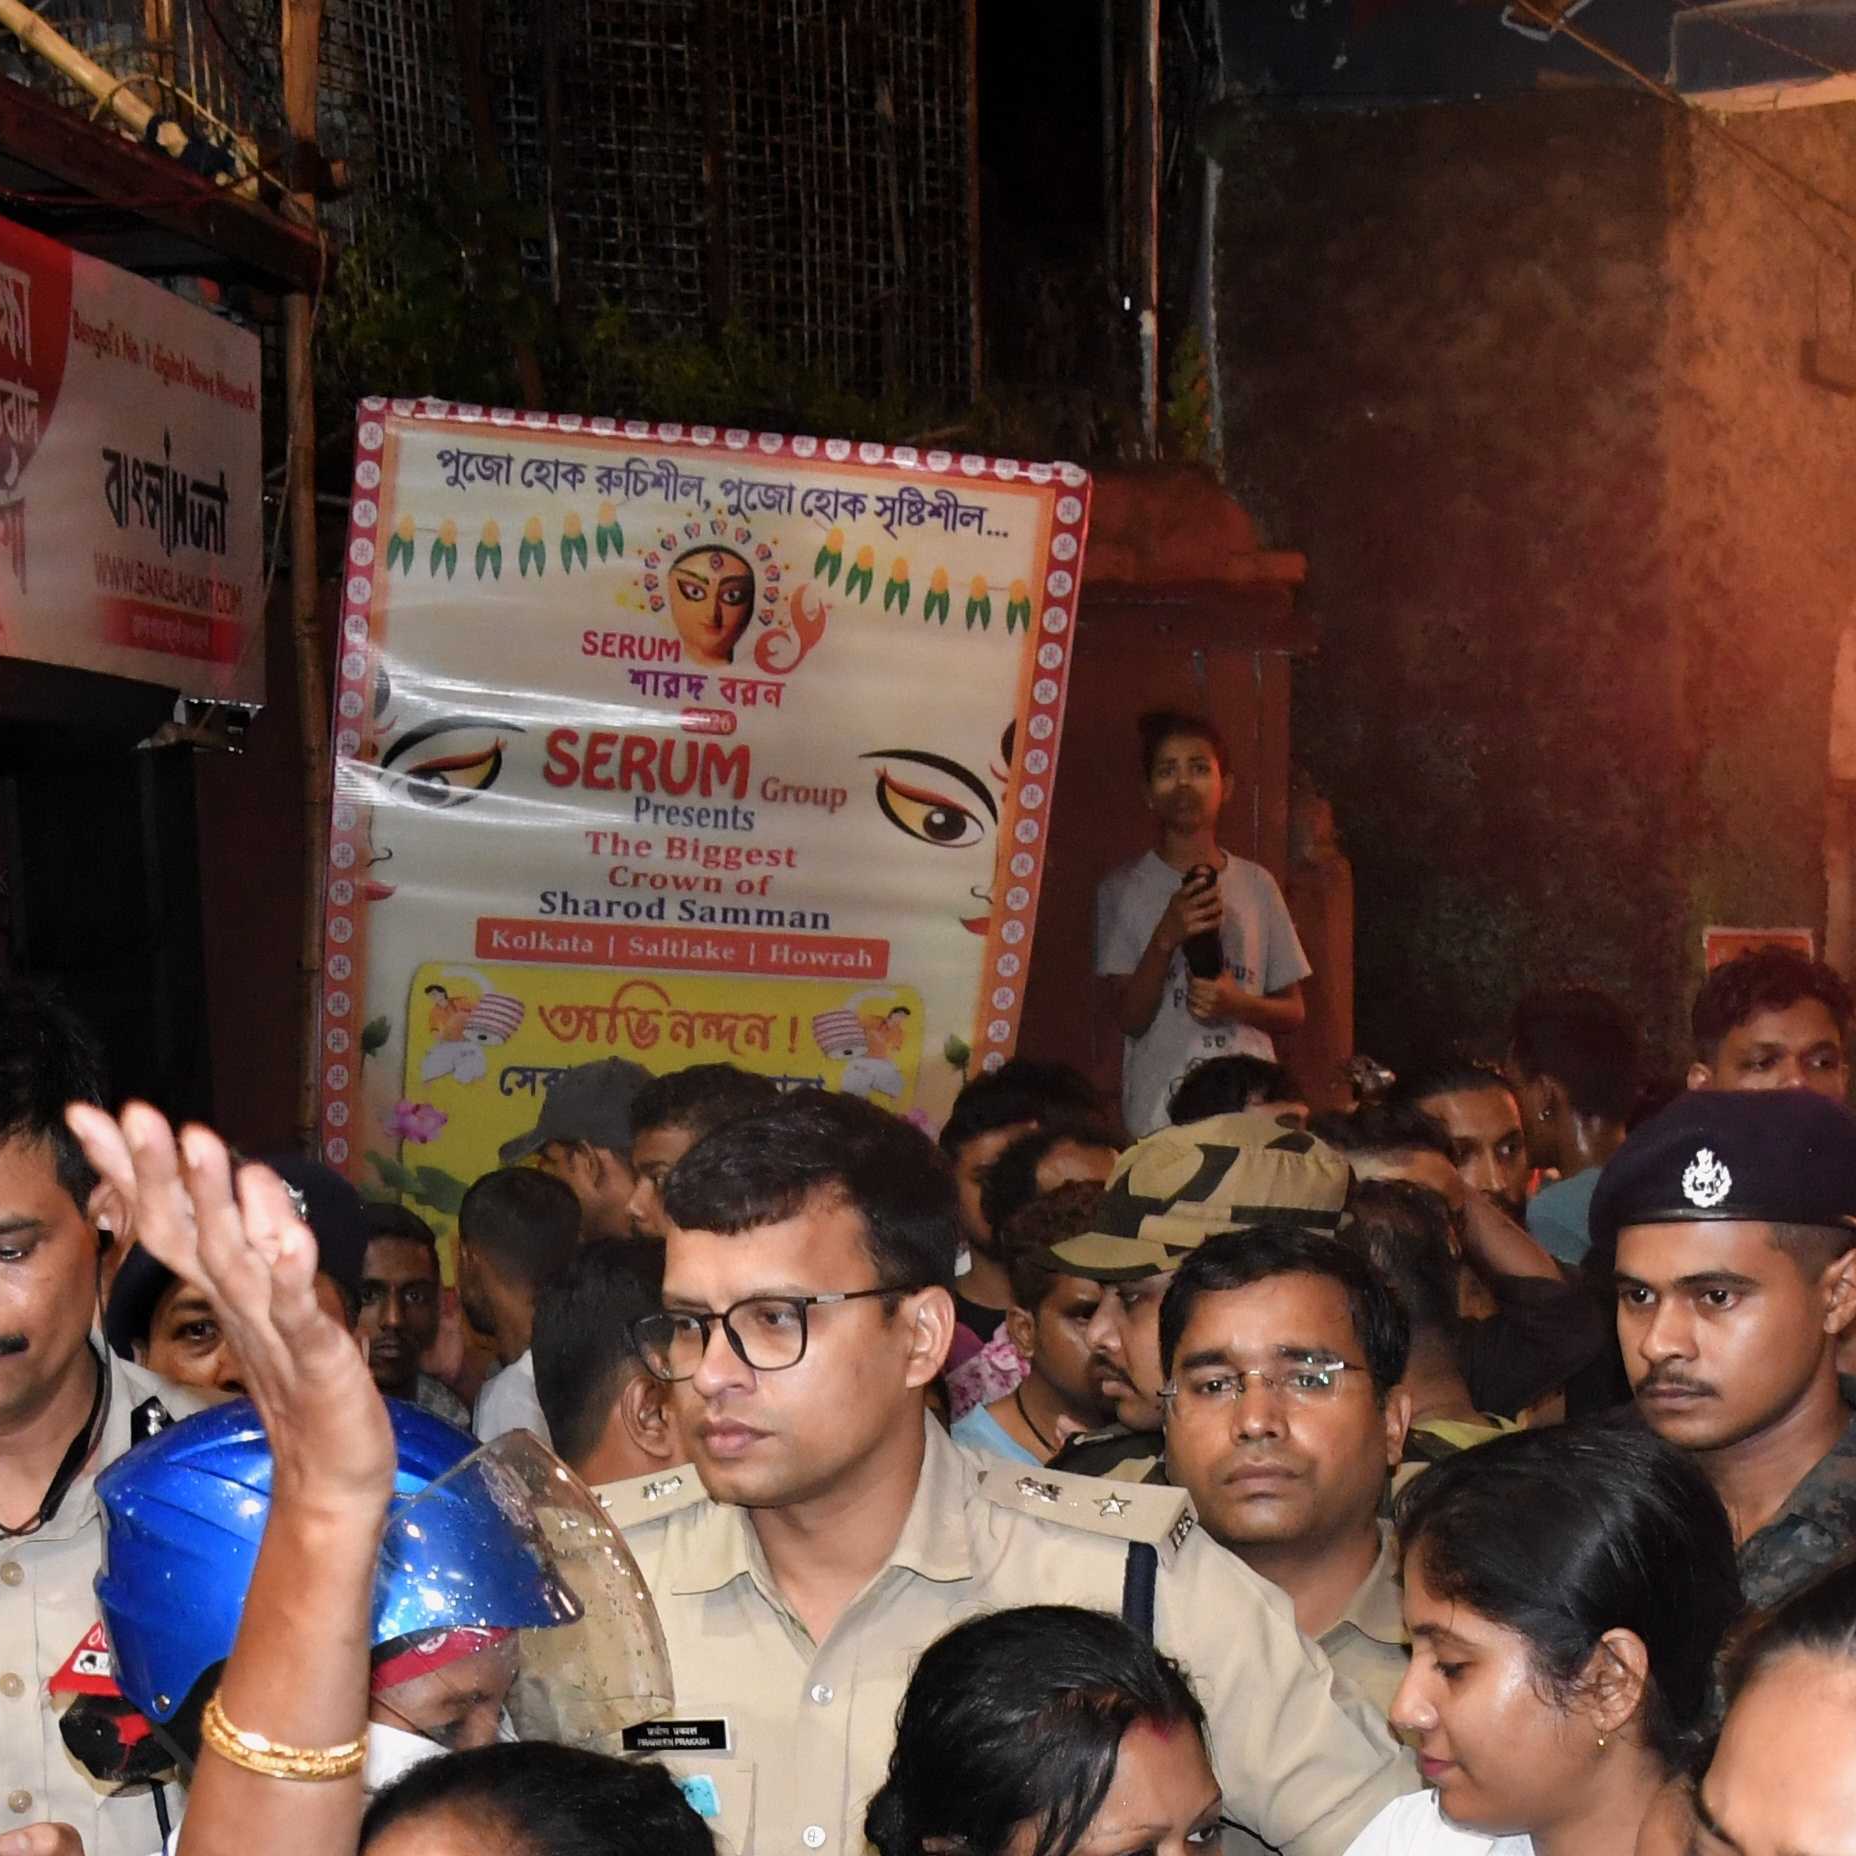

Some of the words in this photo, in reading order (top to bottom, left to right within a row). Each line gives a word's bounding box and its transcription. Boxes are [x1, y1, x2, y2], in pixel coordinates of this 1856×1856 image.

[520, 457, 587, 494] হোক
[800, 487, 868, 524] হোক
[582, 629, 682, 663] SERUM
[544, 727, 752, 801] SERUM
[760, 777, 848, 815] Group
[634, 796, 756, 832] Presents
[585, 830, 653, 859] The
[665, 836, 800, 871] Biggest
[608, 866, 723, 895] Crown
[734, 875, 776, 897] of
[539, 891, 667, 922] Sharod
[677, 900, 832, 931] Samman
[490, 928, 595, 955] Kolkata
[628, 937, 737, 962] Saltlake
[769, 943, 874, 969] Howrah
